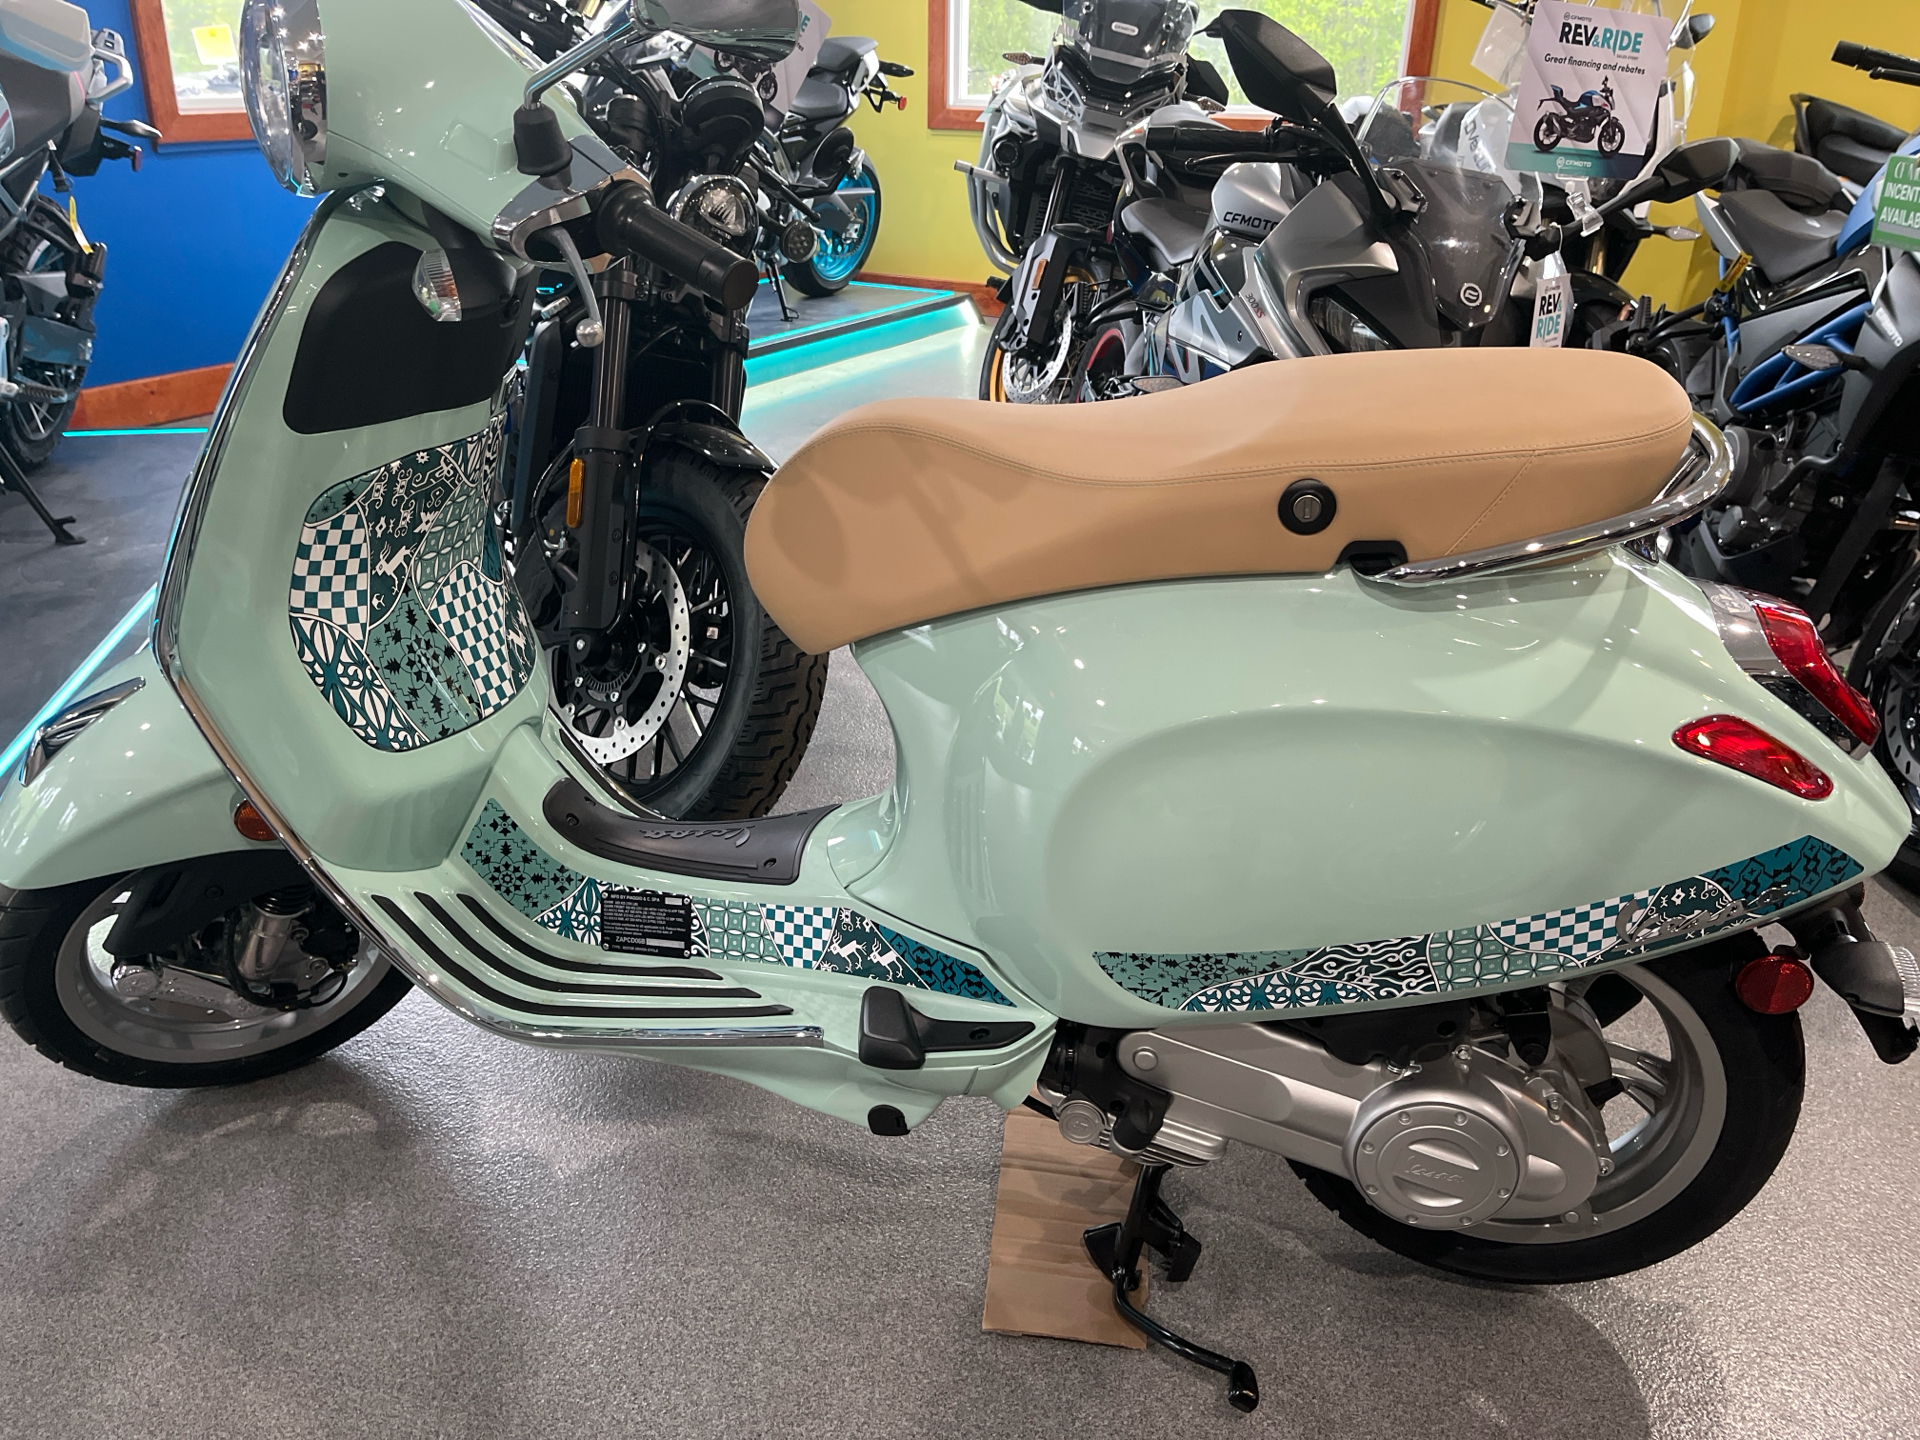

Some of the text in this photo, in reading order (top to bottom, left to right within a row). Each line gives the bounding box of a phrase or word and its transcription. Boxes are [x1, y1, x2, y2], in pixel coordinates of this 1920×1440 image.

[1544, 53, 1646, 75] Great financing and rebates
[1536, 313, 1561, 341] RIDE
